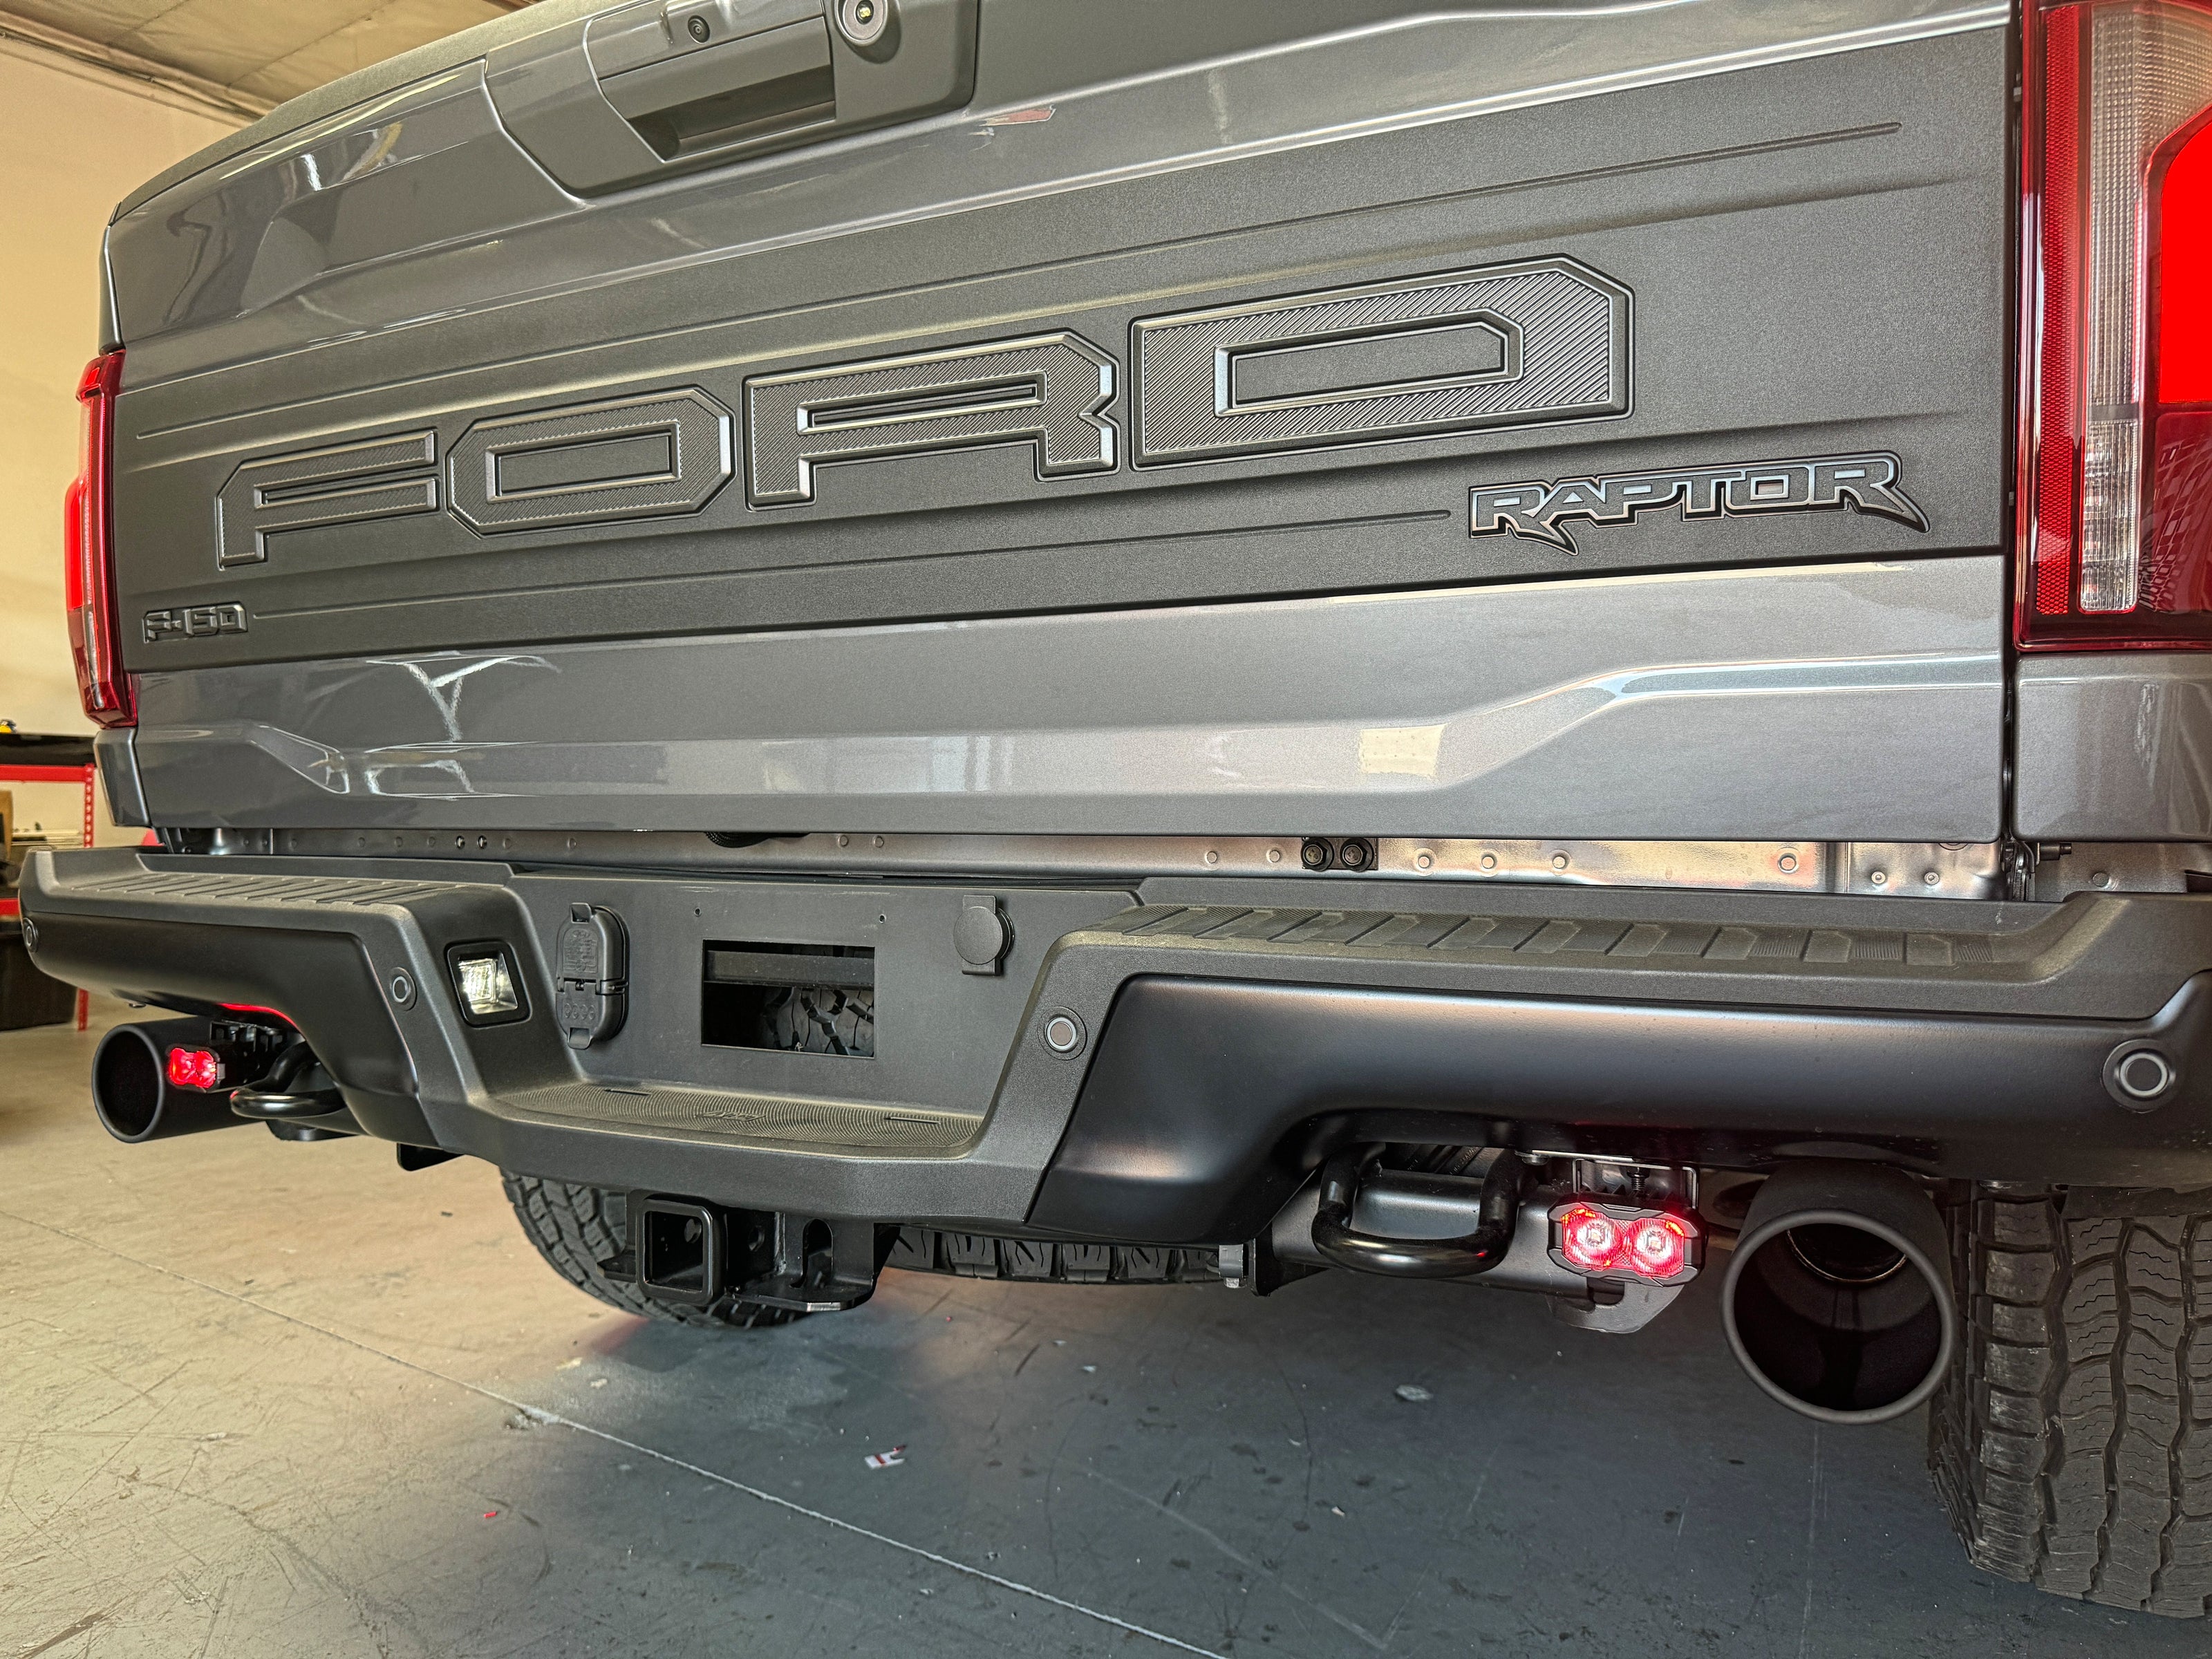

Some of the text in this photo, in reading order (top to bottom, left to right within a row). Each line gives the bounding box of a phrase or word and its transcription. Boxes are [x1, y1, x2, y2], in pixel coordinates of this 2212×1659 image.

[216, 254, 1635, 570] FORD
[1470, 451, 1929, 555] RAPTOR
[142, 601, 247, 644] F-150
